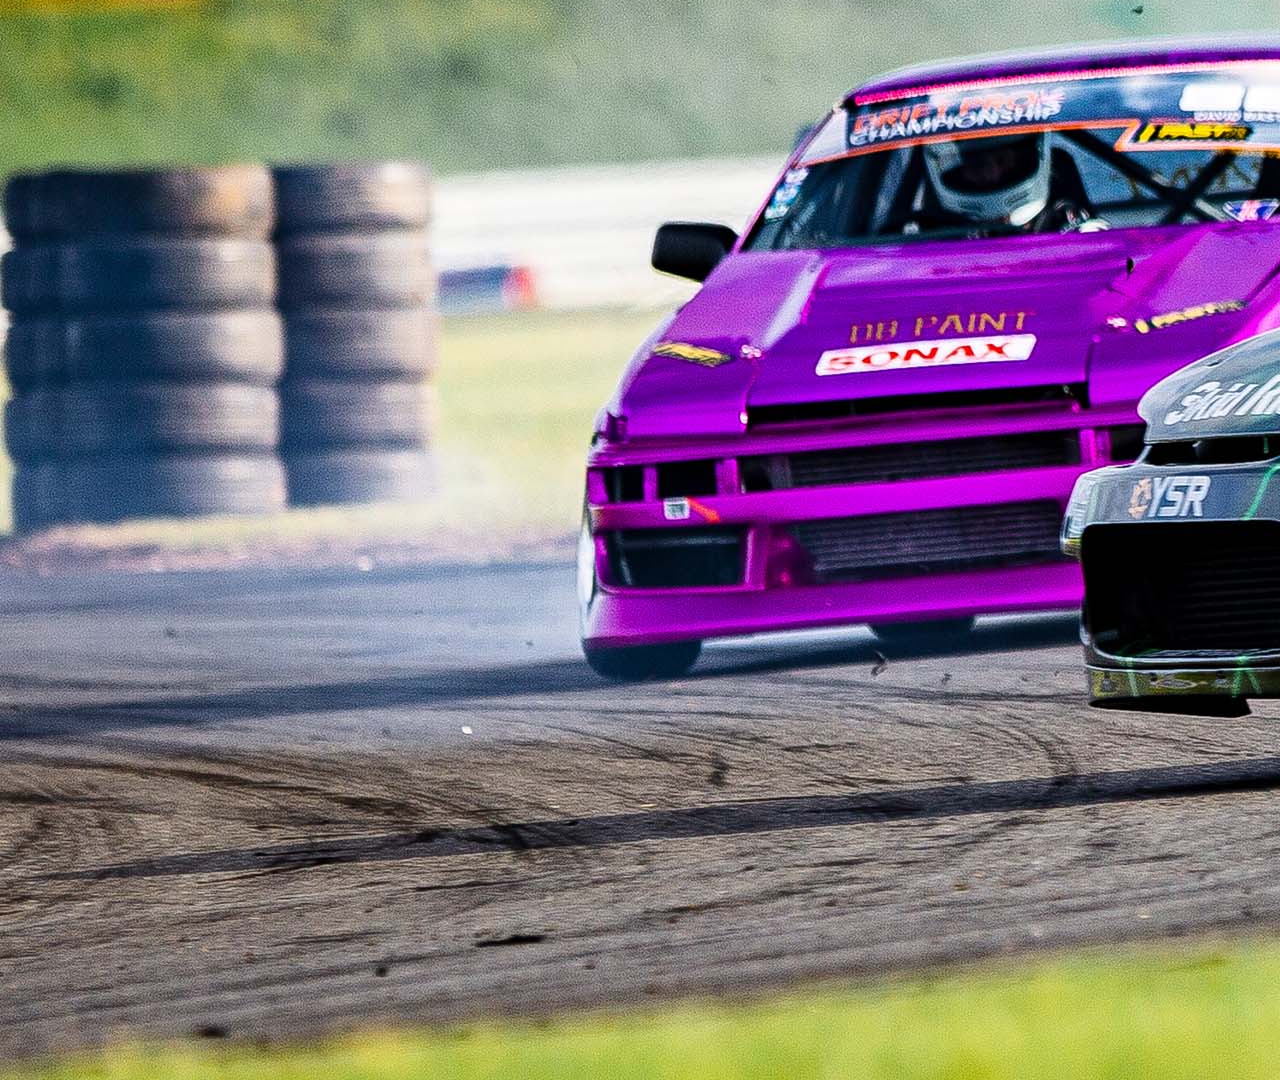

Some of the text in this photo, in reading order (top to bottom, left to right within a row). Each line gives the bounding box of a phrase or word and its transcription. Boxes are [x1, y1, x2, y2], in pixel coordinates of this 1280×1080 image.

[849, 98, 1061, 146] CHAMPIONSHIP
[914, 311, 1036, 337] PAINT
[825, 342, 1011, 370] SONAX
[1147, 475, 1212, 518] YSR
